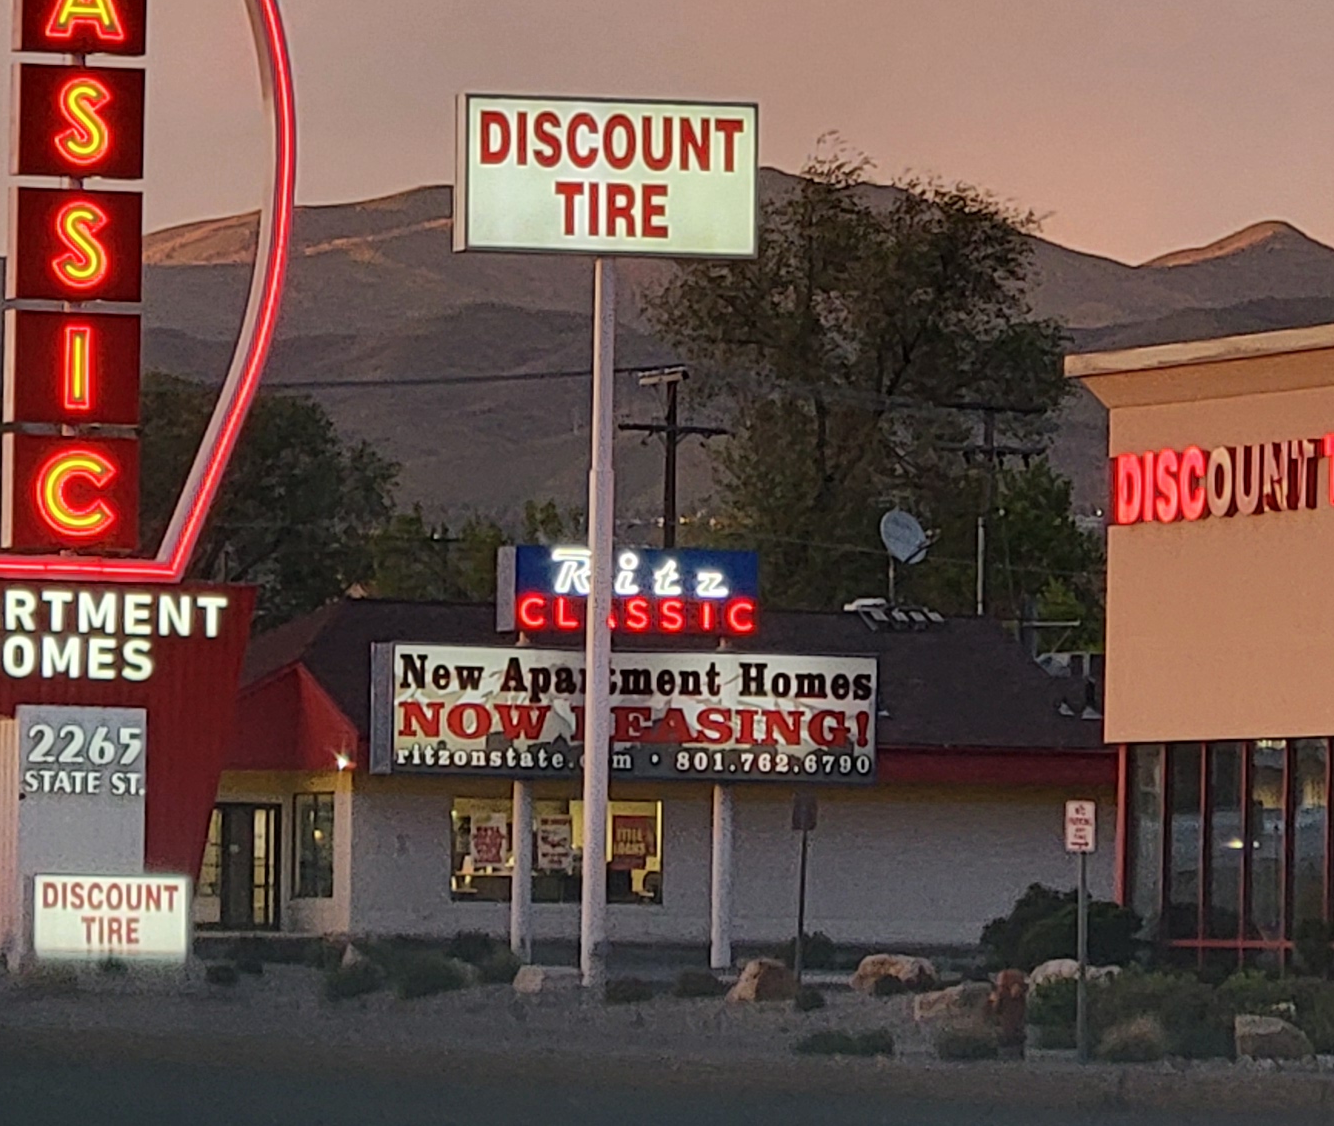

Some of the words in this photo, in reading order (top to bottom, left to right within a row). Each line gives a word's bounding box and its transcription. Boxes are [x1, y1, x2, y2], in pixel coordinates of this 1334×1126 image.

[479, 109, 744, 173] DISCOUNT
[554, 180, 669, 239] TIRE
[1115, 436, 1319, 526] DISCOUNT
[552, 548, 730, 599] Ritz
[517, 593, 758, 633] CLSSIC
[400, 654, 485, 691] New
[739, 662, 873, 701] Homes
[398, 701, 551, 741] NOW
[28, 724, 143, 766] 2265
[396, 746, 633, 770] ritzonstate.m
[675, 752, 871, 775] 801.762.6790
[24, 770, 101, 794] STATE
[111, 772, 146, 796] ST.
[42, 882, 179, 911] DISCOUNT
[81, 915, 140, 945] TIRE
